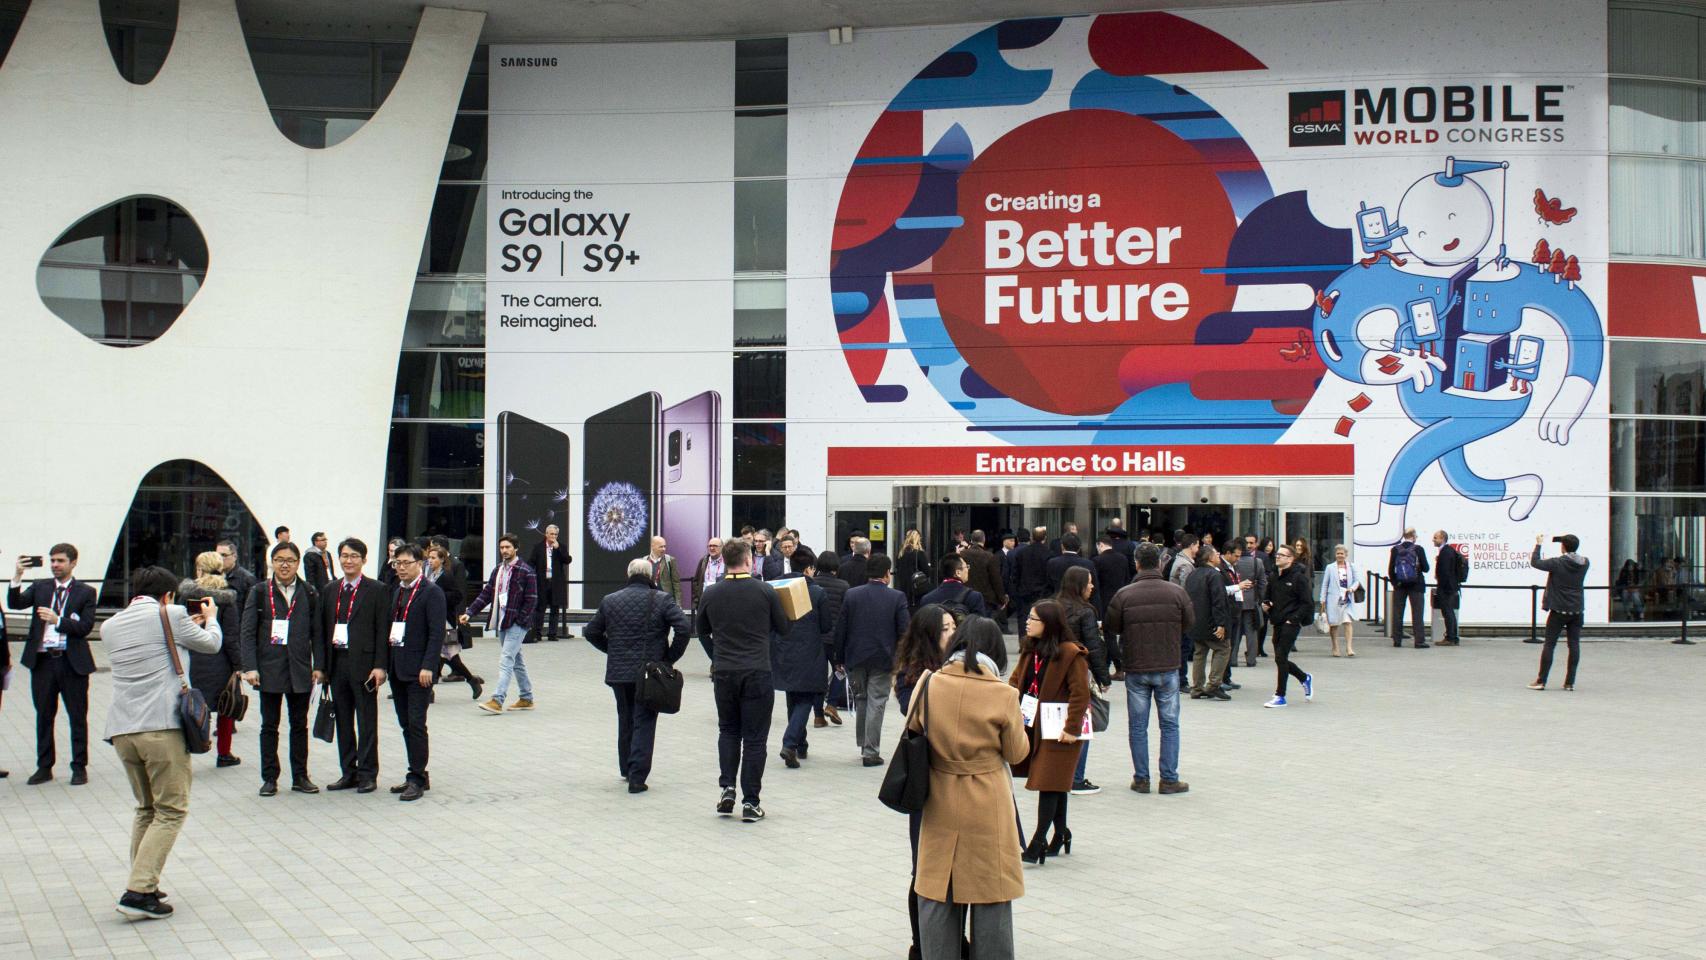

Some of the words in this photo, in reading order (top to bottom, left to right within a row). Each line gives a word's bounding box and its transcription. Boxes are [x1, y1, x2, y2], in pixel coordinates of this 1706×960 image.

[500, 58, 558, 67] SAMSUNG
[1354, 85, 1564, 125] MOBILE
[1292, 124, 1342, 134] GSMA
[1354, 129, 1439, 145] WORLD
[1447, 128, 1565, 143] CONGRESS
[501, 189, 570, 203] Introducing
[573, 189, 594, 200] the
[985, 190, 1083, 213] Creating
[1088, 193, 1101, 208] a
[498, 208, 630, 241] Galaxy
[985, 220, 1182, 269] Better
[500, 244, 543, 273] S9
[583, 244, 640, 273] S9+
[501, 294, 530, 308] The
[533, 294, 603, 308] Camera.
[985, 275, 1190, 324] Future
[500, 315, 597, 331] Reimagined.
[976, 452, 1086, 473] Entrance
[1091, 454, 1117, 473] to
[1123, 451, 1186, 473] Halls
[1458, 533, 1486, 541] EVENT
[1473, 543, 1509, 551] MOBILE
[1473, 552, 1507, 560] WORLD
[1473, 561, 1531, 569] BARCELONA
